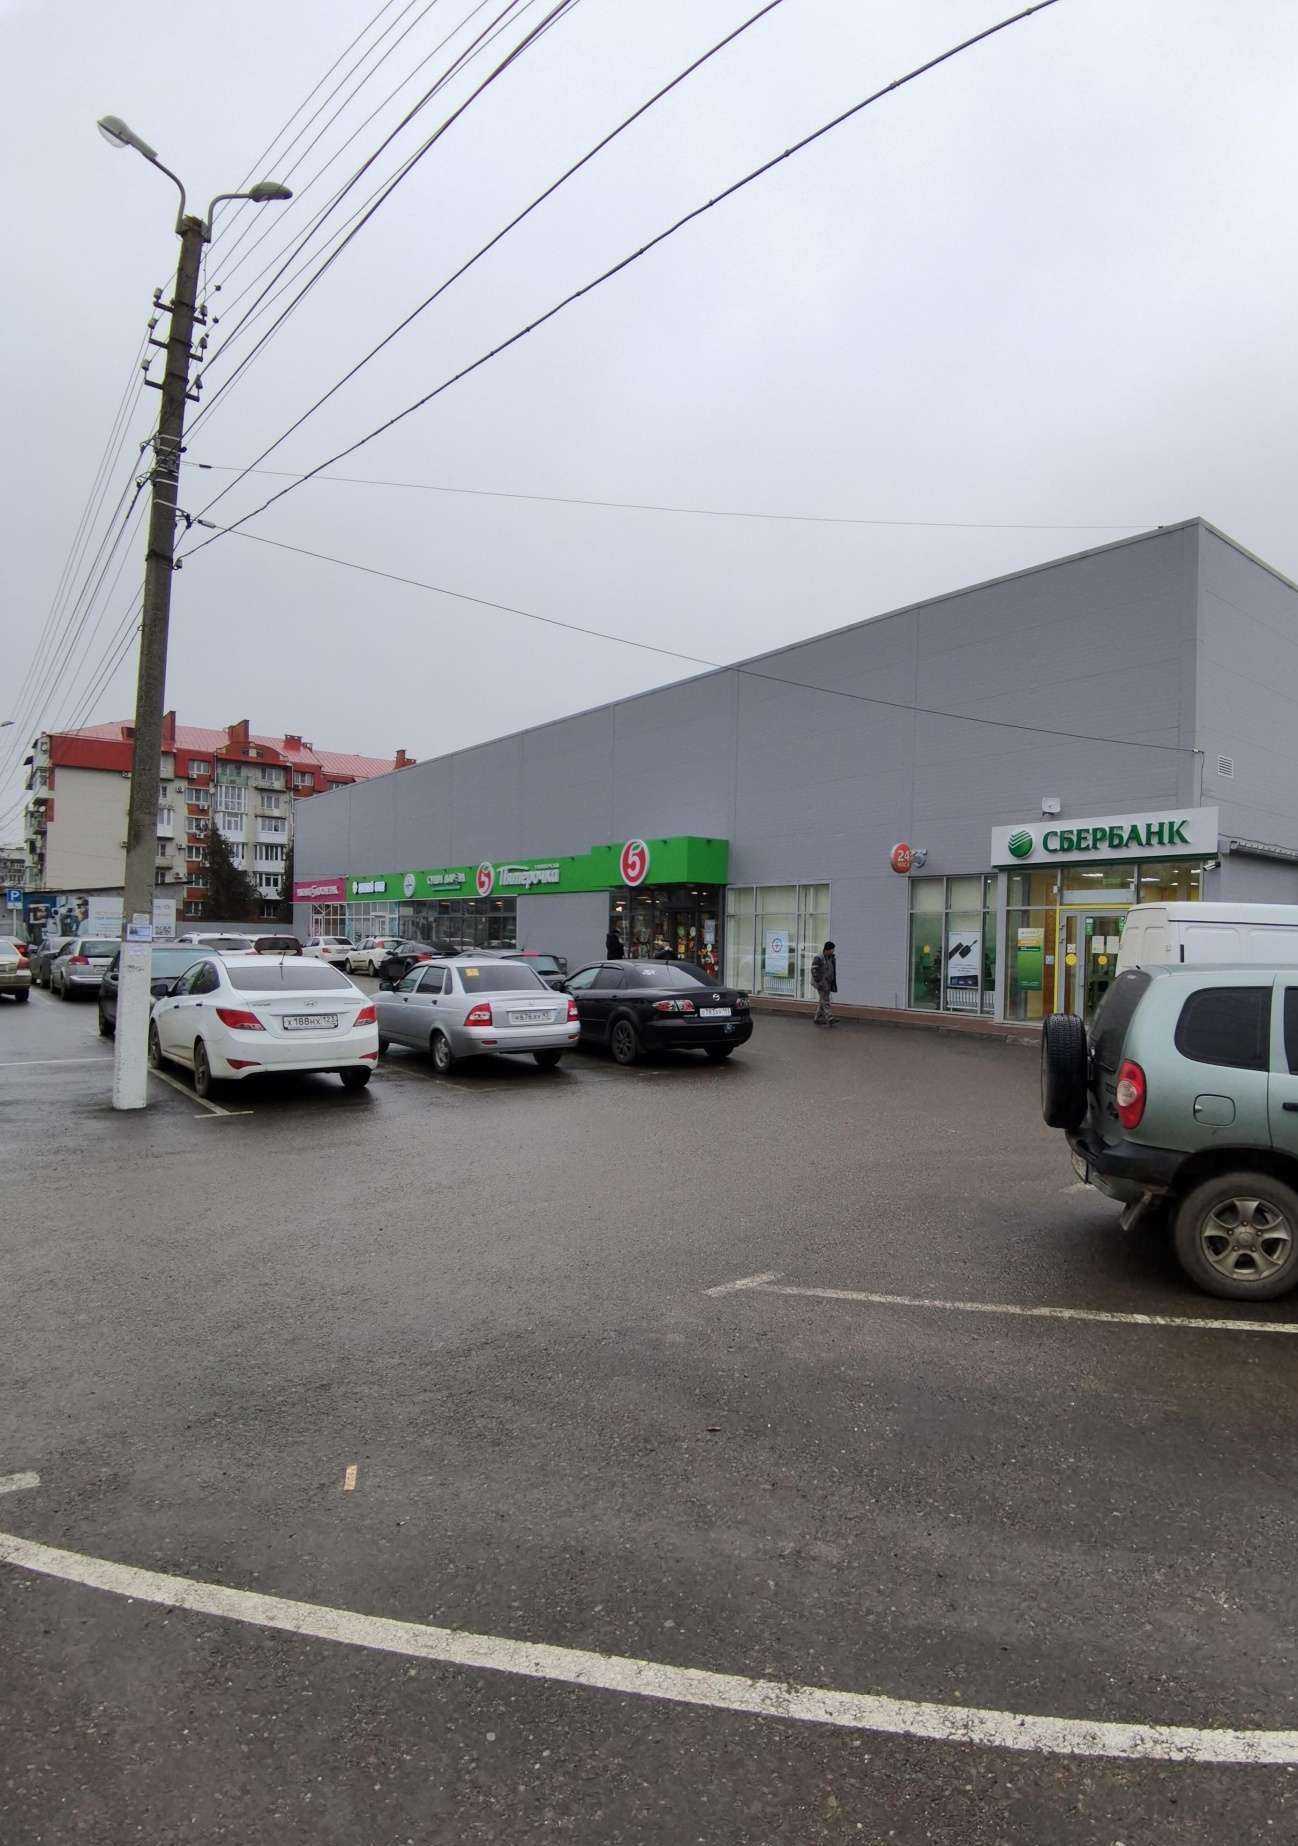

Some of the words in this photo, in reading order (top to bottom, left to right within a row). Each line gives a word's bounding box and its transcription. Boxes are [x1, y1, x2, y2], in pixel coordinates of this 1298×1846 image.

[1042, 819, 1192, 853] СБЕРБАНК
[627, 842, 644, 878] 5
[897, 850, 910, 862] 24
